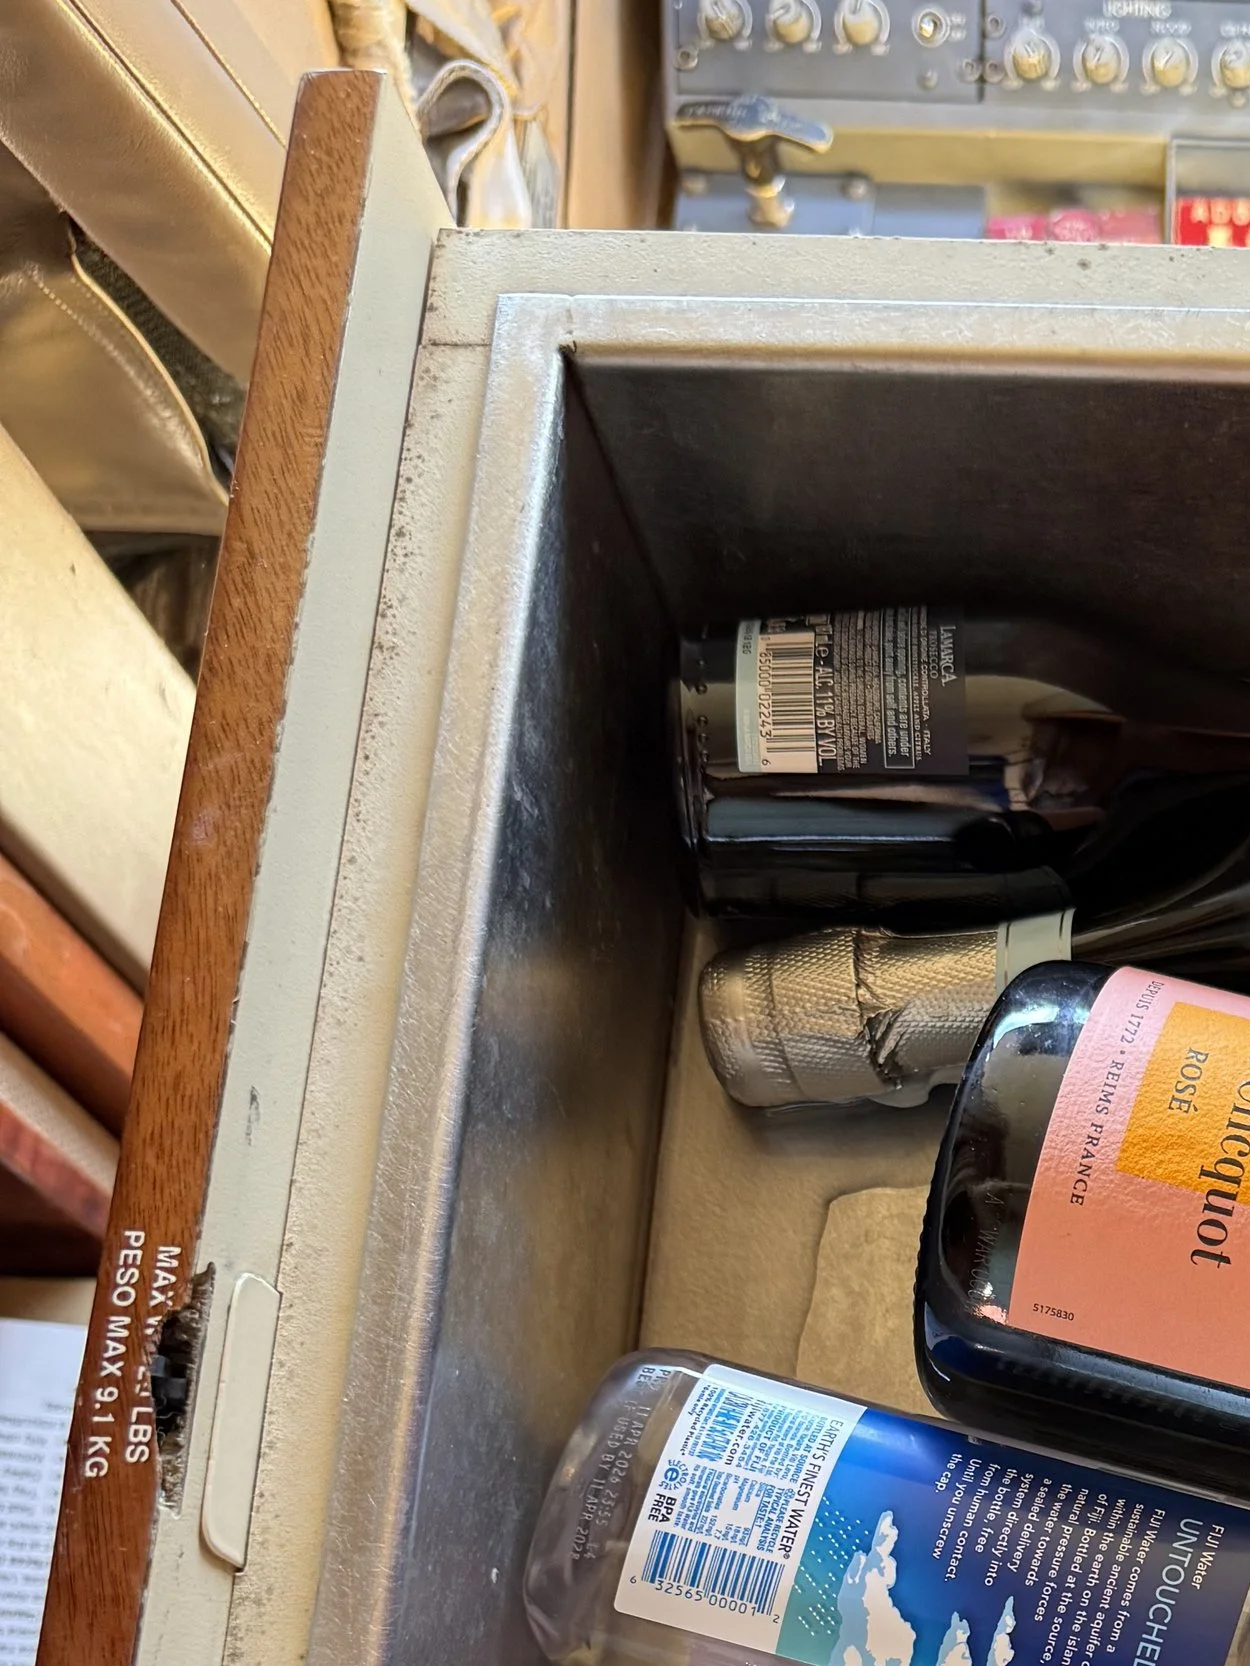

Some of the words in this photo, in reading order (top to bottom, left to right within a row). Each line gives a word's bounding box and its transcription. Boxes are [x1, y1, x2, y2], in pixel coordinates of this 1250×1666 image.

[758, 694, 771, 737] 02243
[818, 719, 835, 736] BY
[886, 711, 896, 725] and
[899, 714, 908, 728] are
[817, 738, 836, 766] VOL.
[899, 731, 910, 757] under
[1132, 979, 1165, 1012] DEPUIS
[1118, 1012, 1146, 1046] 1772
[1091, 1058, 1125, 1117] REIMS
[1165, 1045, 1211, 1115] ROSÉ
[1067, 1121, 1105, 1207] FRANCE
[112, 1230, 145, 1306] PESO
[1030, 1301, 1076, 1321] 5175830
[99, 1316, 131, 1376] MAX
[91, 1386, 118, 1422] 9.1
[124, 1404, 155, 1465] LBS
[624, 1420, 644, 1447] APR
[810, 1418, 843, 1461] EARTH'S
[84, 1436, 112, 1477] KG
[597, 1452, 614, 1471] BY
[793, 1461, 821, 1506] FINEST
[579, 1494, 597, 1522] APR
[647, 1492, 665, 1522] FREE
[658, 1496, 677, 1524] BPA
[1106, 1499, 1125, 1529] within
[1149, 1508, 1165, 1527] FIJI
[1098, 1532, 1114, 1550] the
[1115, 1503, 1144, 1561] sustainable
[1136, 1530, 1157, 1564] Water
[1205, 1524, 1224, 1548] FIJI
[1086, 1554, 1103, 1586] earth
[1120, 1566, 1140, 1606] comes
[1191, 1551, 1215, 1589] Water
[654, 1579, 704, 1601] 32565
[708, 1594, 758, 1618] 00001
[1079, 1590, 1091, 1606] on
[1099, 1564, 1120, 1609] ancient
[1072, 1610, 1087, 1632] the
[1085, 1611, 1105, 1658] aquifer
[1110, 1610, 1130, 1640] from
[1106, 1644, 1115, 1652] a
